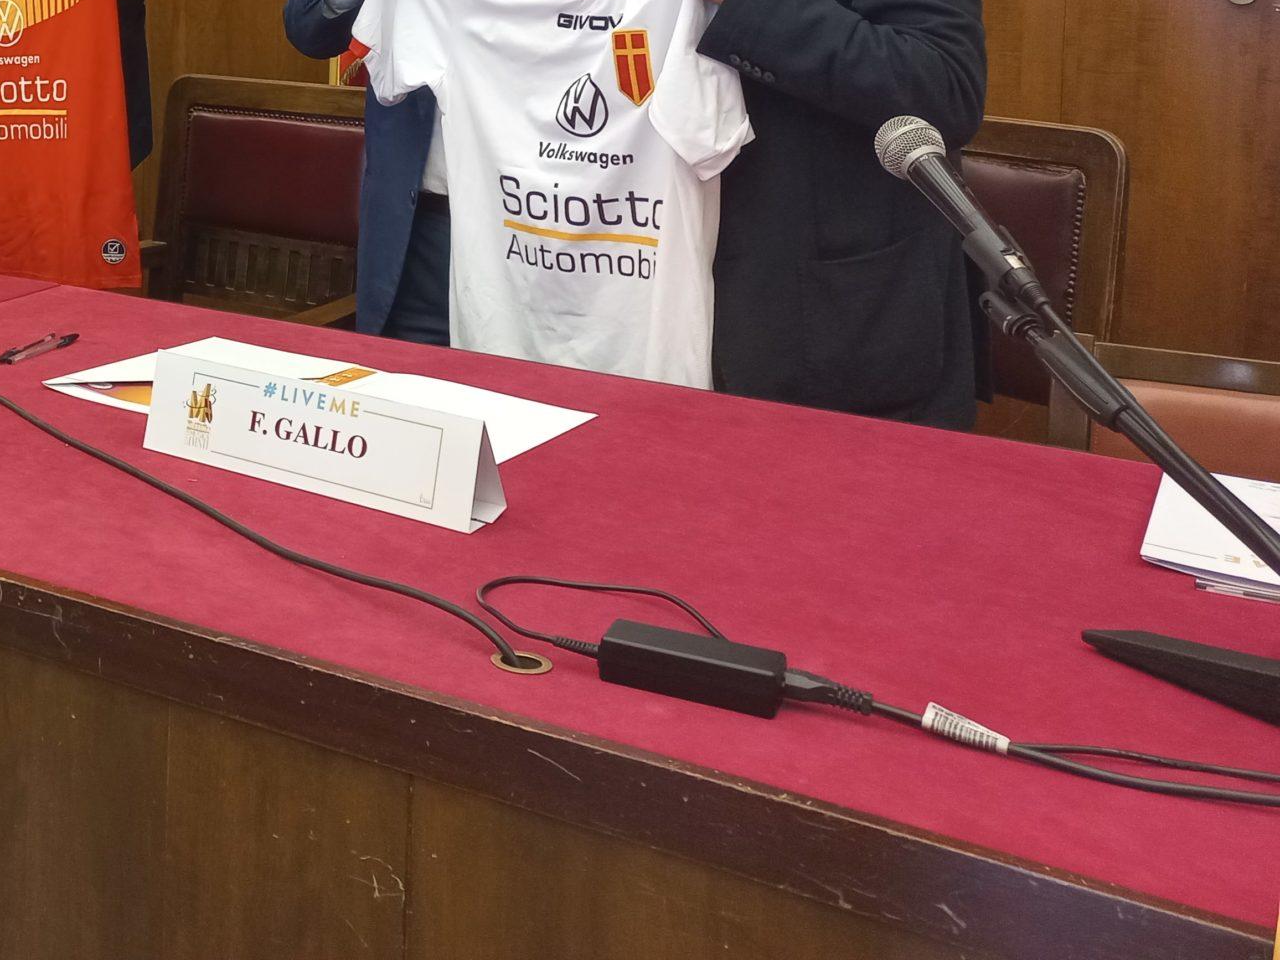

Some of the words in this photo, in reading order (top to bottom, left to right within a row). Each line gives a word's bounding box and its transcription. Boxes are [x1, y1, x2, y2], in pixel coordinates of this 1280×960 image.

[537, 141, 634, 169] Volkswagen
[263, 382, 361, 418] #LIVEME
[248, 410, 268, 436] F.
[274, 417, 368, 459] GALLO
